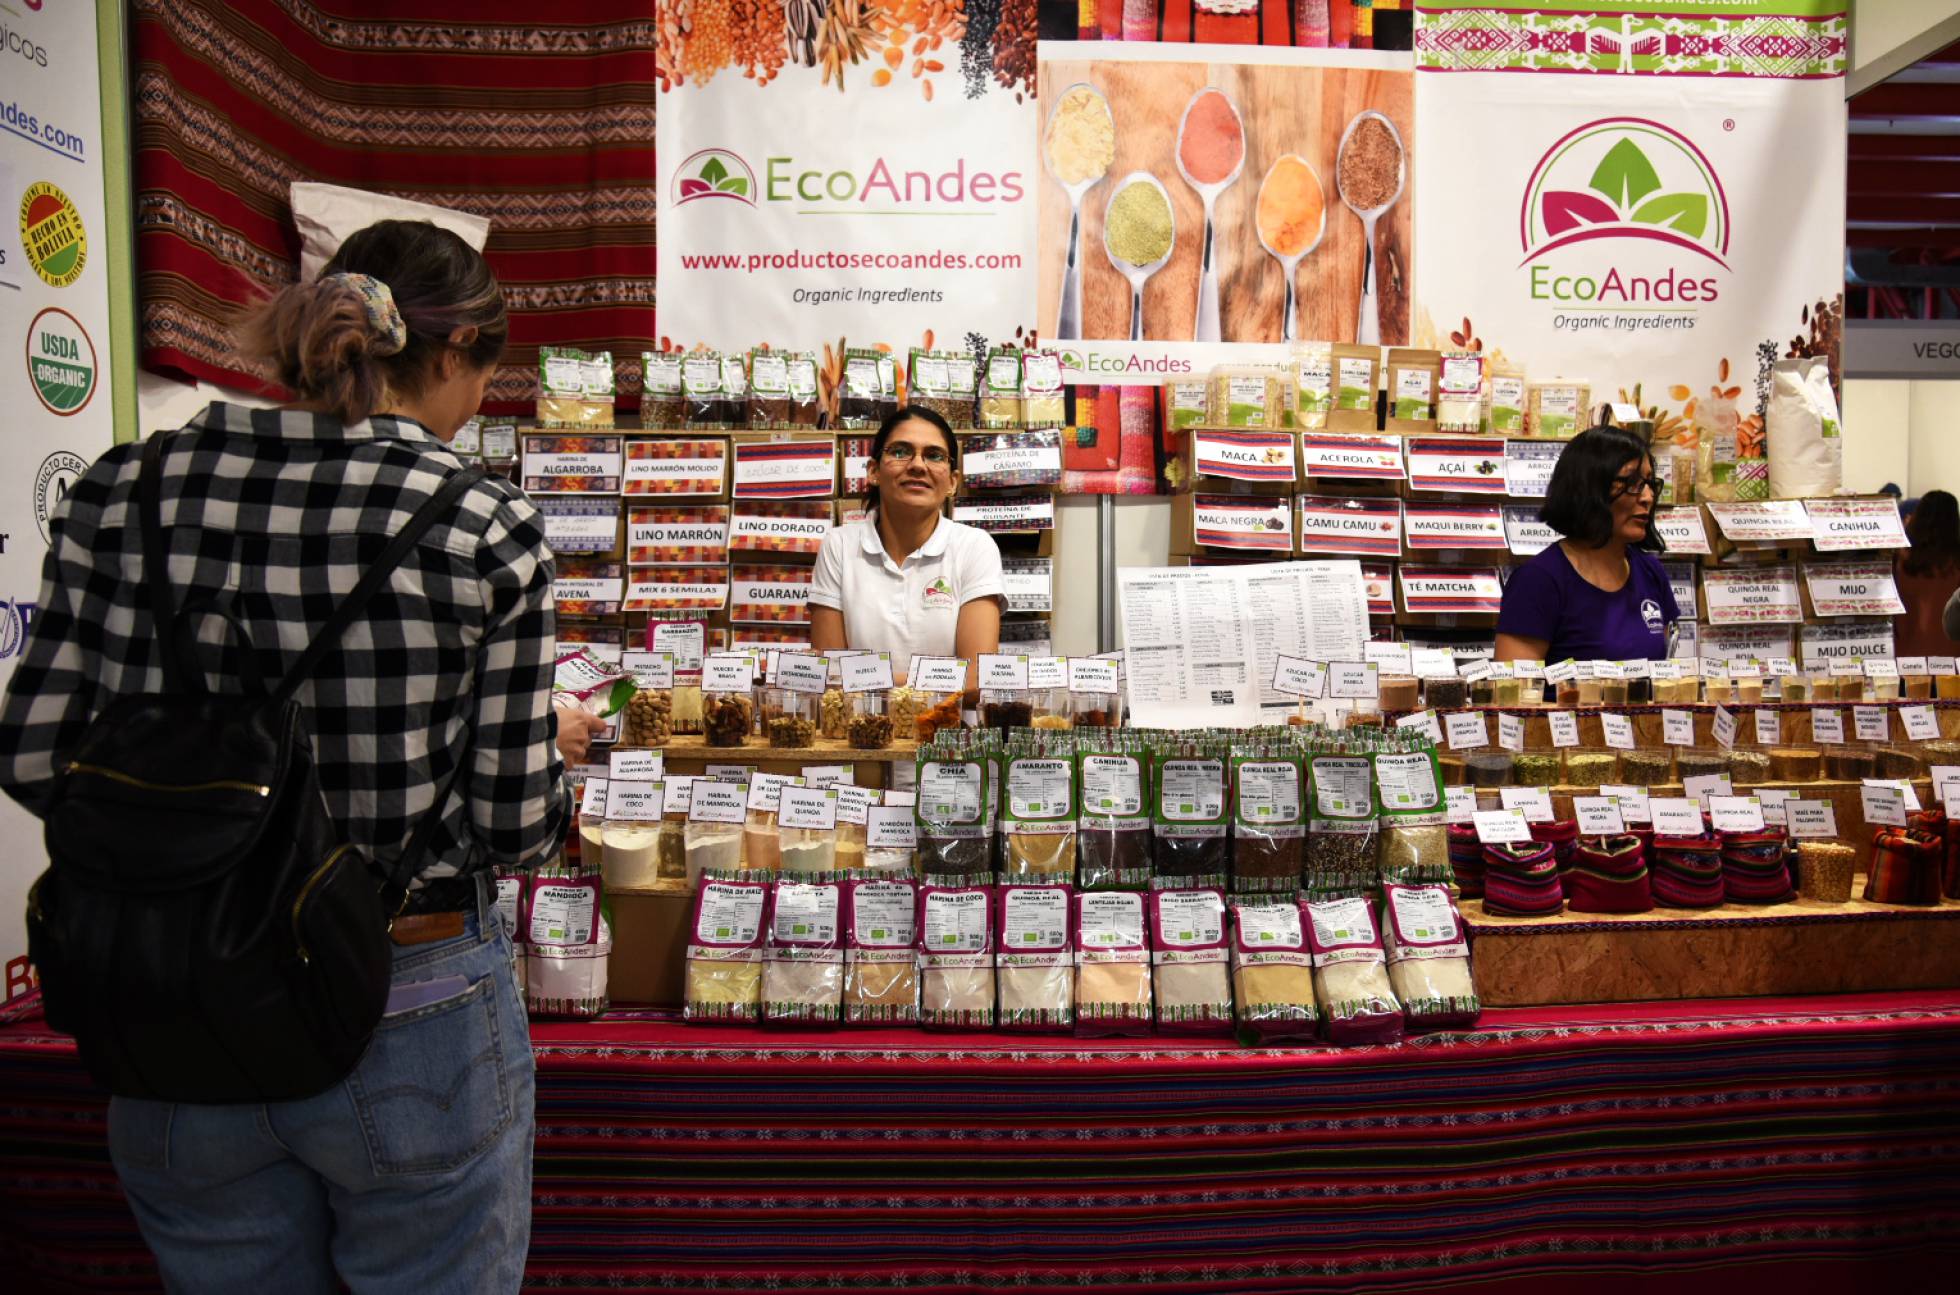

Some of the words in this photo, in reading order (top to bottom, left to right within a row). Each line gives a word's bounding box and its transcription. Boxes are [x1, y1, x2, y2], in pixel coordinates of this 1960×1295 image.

[767, 157, 1024, 202] EcoAndes
[36, 226, 75, 261] BOLIVIA
[681, 249, 1022, 273] www.productosecoandes.com
[1530, 265, 1718, 303] EcoAndes
[793, 286, 853, 304] Organic
[857, 286, 944, 304] Ingredients
[1553, 314, 1609, 332] Organic
[1613, 314, 1697, 330] Ingredients
[41, 331, 79, 361] USDA
[1088, 353, 1191, 374] EcoAndes
[37, 366, 86, 388] ORGANIC
[985, 450, 1027, 461] PROTEÍNA
[1029, 450, 1039, 458] DE
[1221, 450, 1257, 463] MACA
[1320, 453, 1374, 464] ACEROLA
[543, 465, 604, 474] ALGARROBA
[631, 464, 651, 473] LINO
[652, 463, 685, 474] MARRÓN
[687, 464, 719, 473] MOLIDO
[1438, 460, 1466, 475] AÇAÍ
[37, 457, 60, 522] PRODUCTO
[1198, 514, 1228, 525] MACA
[1230, 516, 1265, 527] NEGRA
[1306, 518, 1340, 530] CAMU
[1342, 519, 1377, 531] CAMU
[1732, 517, 1769, 526] QUINOA
[738, 521, 767, 532] LINO
[771, 522, 825, 535] DORADO
[1415, 521, 1451, 532] MAQUI
[1453, 521, 1484, 531] BERRY
[1829, 522, 1880, 532] CANIHUA
[635, 530, 664, 541] LINO
[667, 527, 722, 541] MARRÓN
[1520, 529, 1551, 537] ARROZ
[638, 586, 657, 594] MIX
[660, 586, 667, 594] 6
[669, 586, 717, 595] SEMILLAS
[1409, 582, 1422, 592] TÉ
[1425, 583, 1476, 592] MATCHA
[1727, 585, 1760, 594] QUINOA
[1762, 584, 1781, 592] REAL
[1840, 585, 1866, 595] MIJO
[556, 589, 590, 599] AVENA
[1742, 595, 1769, 603] NEGRA
[1718, 642, 1751, 651] QUINOA
[1752, 641, 1771, 650] REAL
[1818, 646, 1848, 657] MIJO
[1850, 644, 1887, 656] DULCE
[1092, 758, 1128, 766] CANIHUA
[1406, 756, 1428, 764] REAL
[543, 891, 588, 899] MANDIOCA
[708, 886, 733, 895] HARINA
[871, 953, 911, 961] EcoAndes
